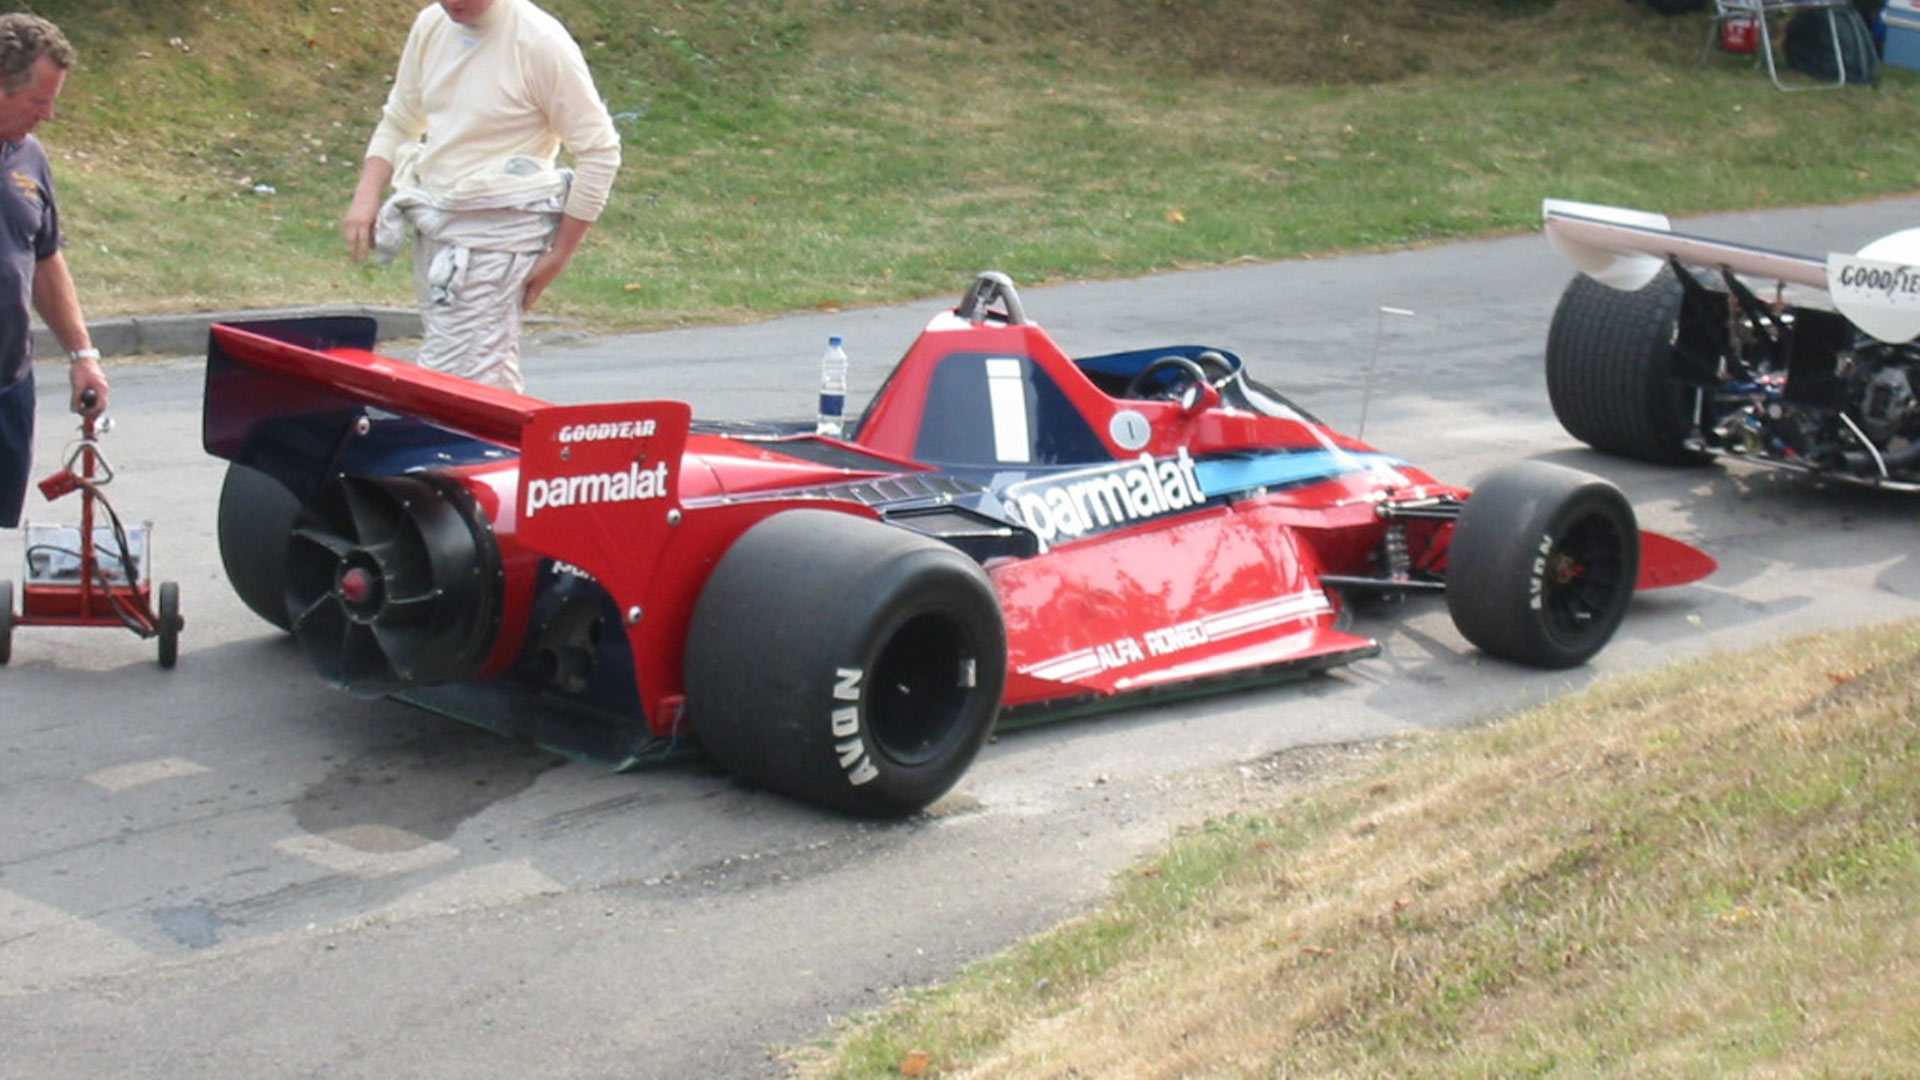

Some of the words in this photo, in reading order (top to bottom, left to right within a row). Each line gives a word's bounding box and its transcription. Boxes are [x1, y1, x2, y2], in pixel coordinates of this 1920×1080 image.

[558, 419, 657, 442] GOODYEAR
[525, 460, 668, 518] parmalat
[1017, 445, 1206, 554] parmalat
[1529, 534, 1553, 610] AVON
[1096, 637, 1146, 672] ALFA
[1143, 619, 1210, 657] ROMEO
[831, 667, 879, 786] AVON
